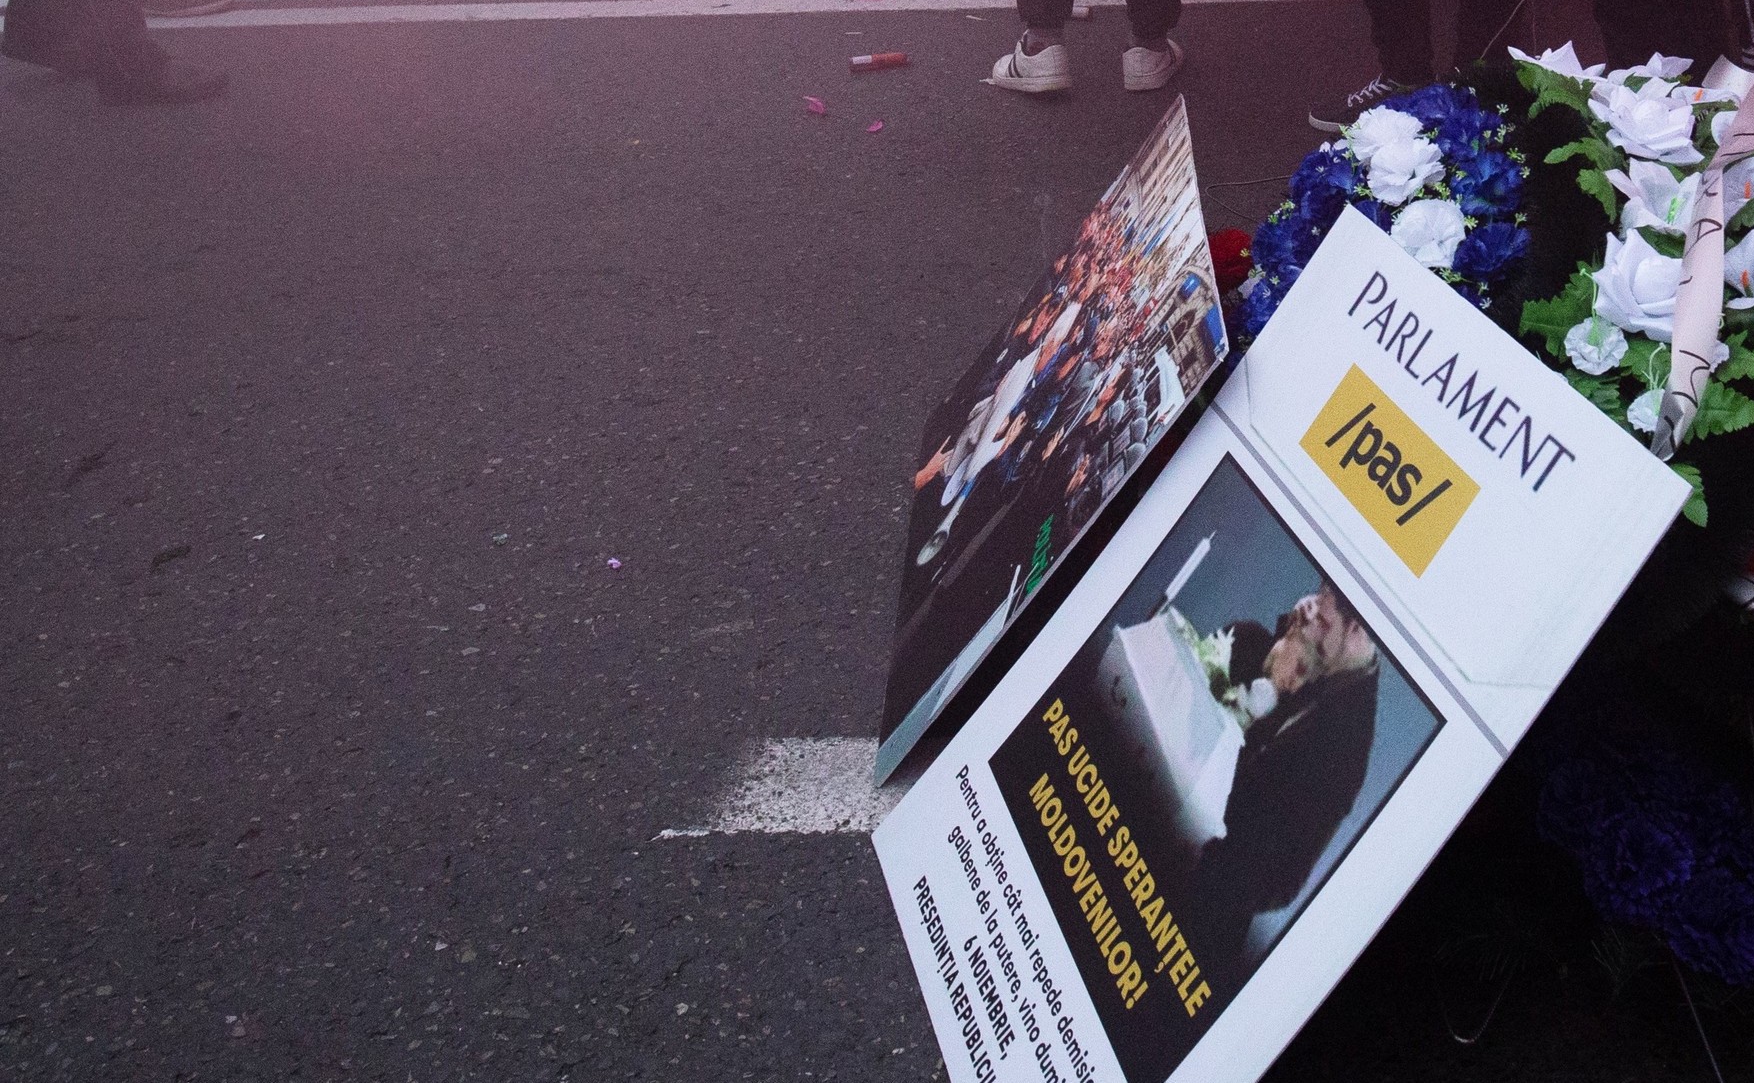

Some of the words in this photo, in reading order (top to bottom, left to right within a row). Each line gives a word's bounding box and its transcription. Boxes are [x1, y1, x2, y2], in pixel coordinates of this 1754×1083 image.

[1347, 270, 1576, 493] PARLAMENT
[1324, 402, 1453, 527] /pas/
[947, 825, 981, 891] galbene
[955, 764, 982, 821] Pentru
[976, 821, 986, 834] a
[981, 829, 1008, 885] obține
[1003, 887, 1023, 917] cât
[1015, 913, 1040, 951] mai
[1029, 949, 1062, 1017] repede
[975, 890, 992, 915] de
[1028, 773, 1149, 1010] MOLDOVENILOR!
[1042, 698, 1078, 756] PAS
[1067, 745, 1121, 836] UCIDE
[1107, 825, 1212, 1018] SPERANȚELE
[913, 875, 960, 991] PREȘEDINȚIA
[963, 935, 978, 952] 6
[984, 910, 998, 935] la
[988, 932, 1022, 1003] putere,
[967, 952, 1016, 1061] NOIEMBRIE,
[1018, 996, 1041, 1043] vino
